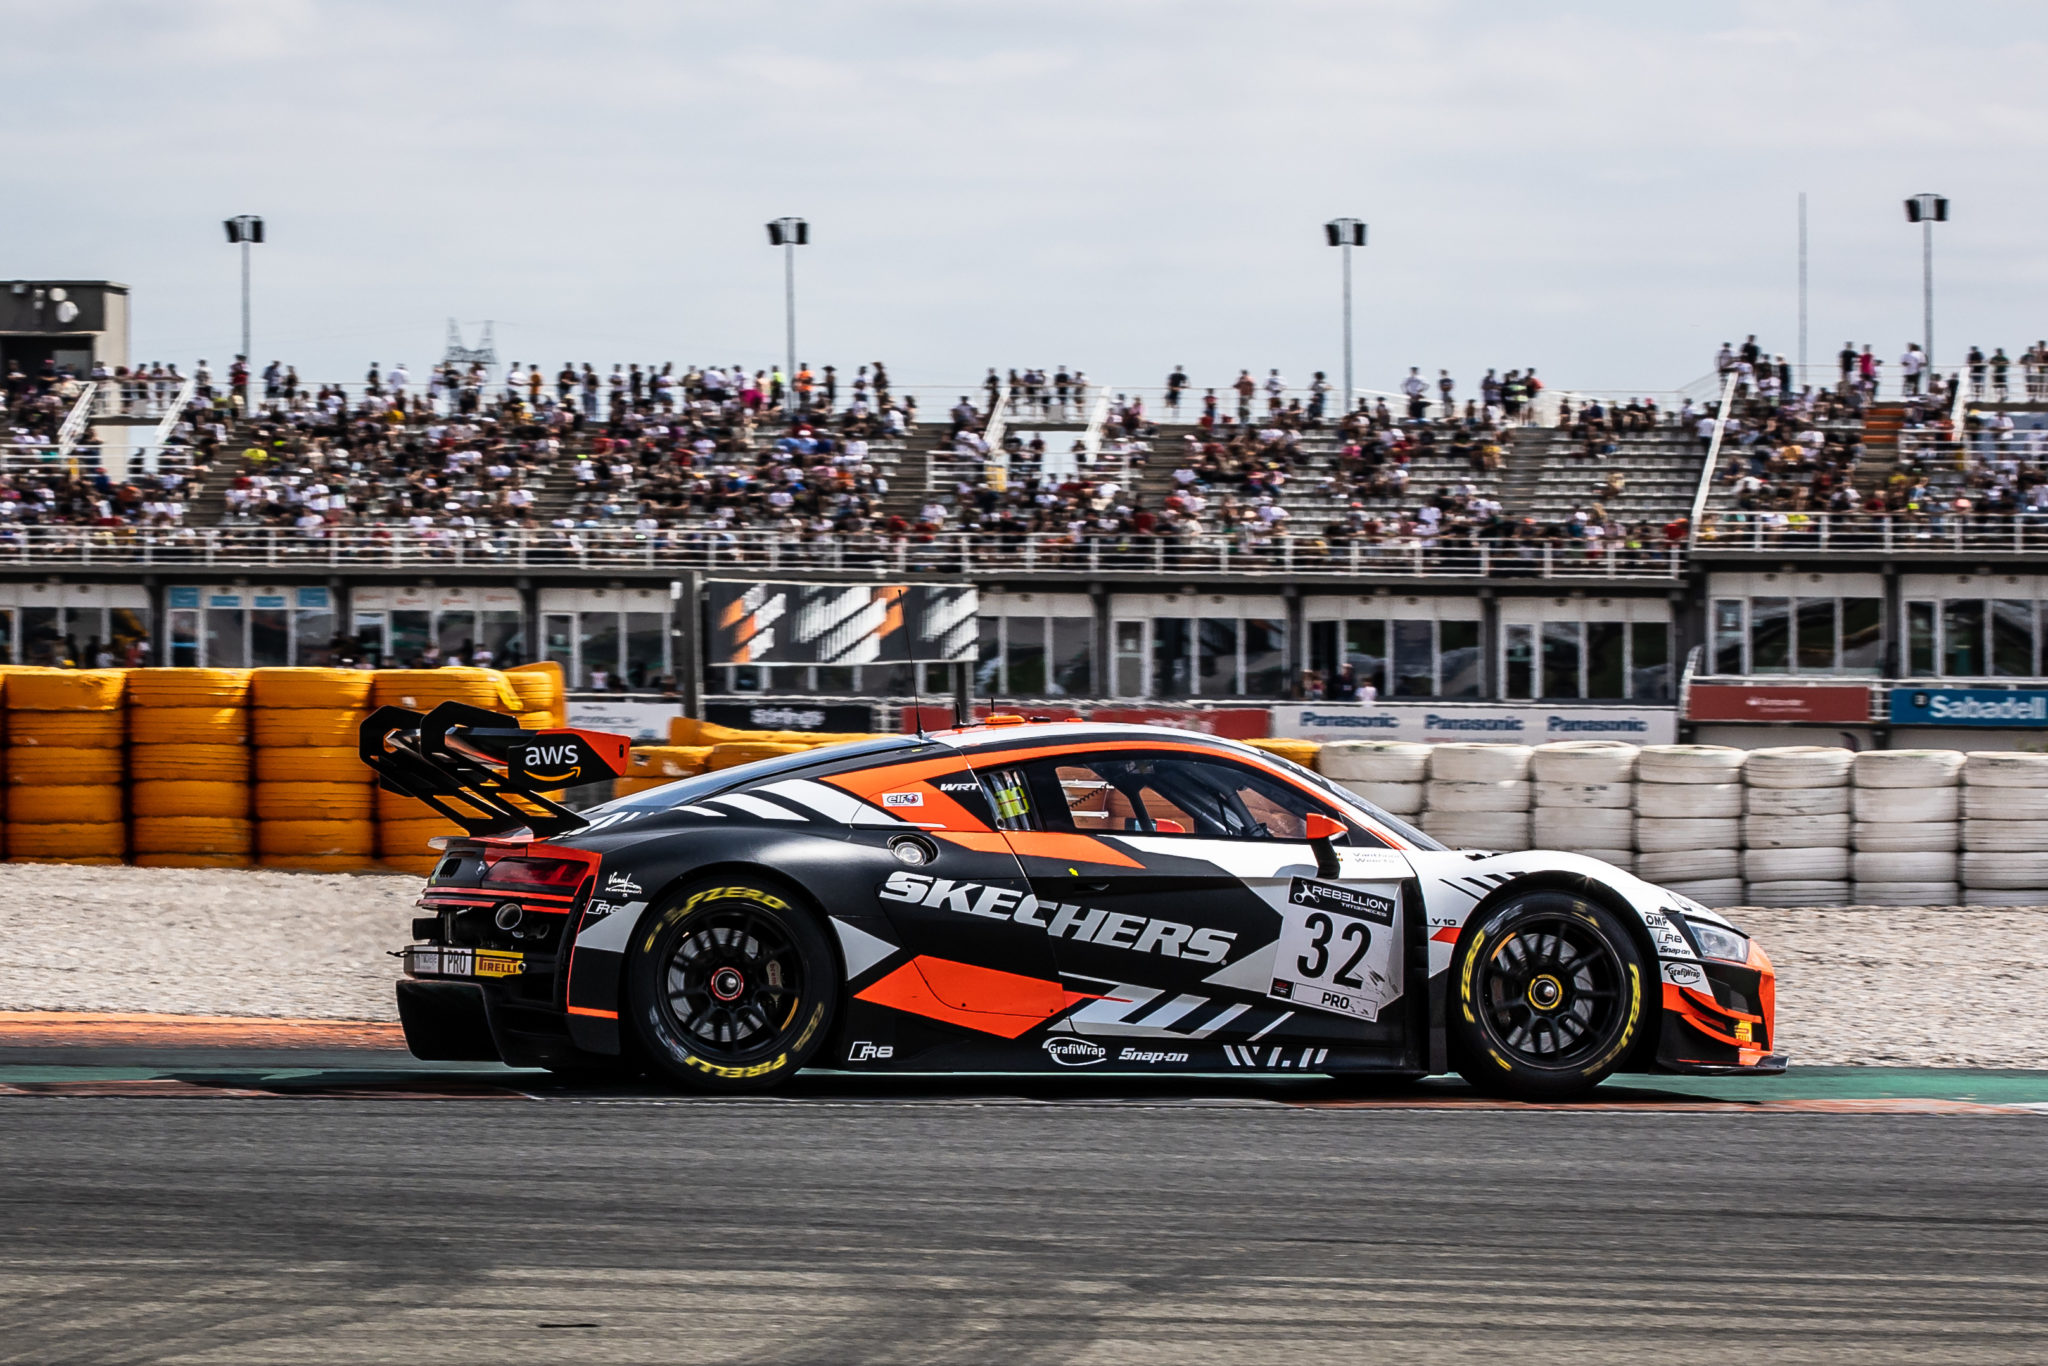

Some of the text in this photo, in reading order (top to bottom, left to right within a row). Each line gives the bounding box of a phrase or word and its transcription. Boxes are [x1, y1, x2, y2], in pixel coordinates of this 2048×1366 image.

[1929, 695, 2047, 719] Sabadell
[1300, 712, 1649, 732] Panasonic Panasonic Panasonic
[525, 744, 579, 766] aws
[940, 783, 980, 791] WRT
[886, 793, 907, 805] elf
[1312, 885, 1389, 912] REBELLION
[879, 871, 1238, 965] SKECHERS
[1645, 914, 1668, 927] OMP
[1297, 912, 1372, 989] 32
[1659, 945, 1691, 956] Snap-on
[447, 950, 466, 974] PRO
[479, 956, 518, 974] PIRELLI
[1321, 992, 1350, 1010] PRO
[857, 1044, 894, 1059] R8
[1048, 1043, 1107, 1058] GrafiWrap
[1119, 1047, 1189, 1064] Snap-on
